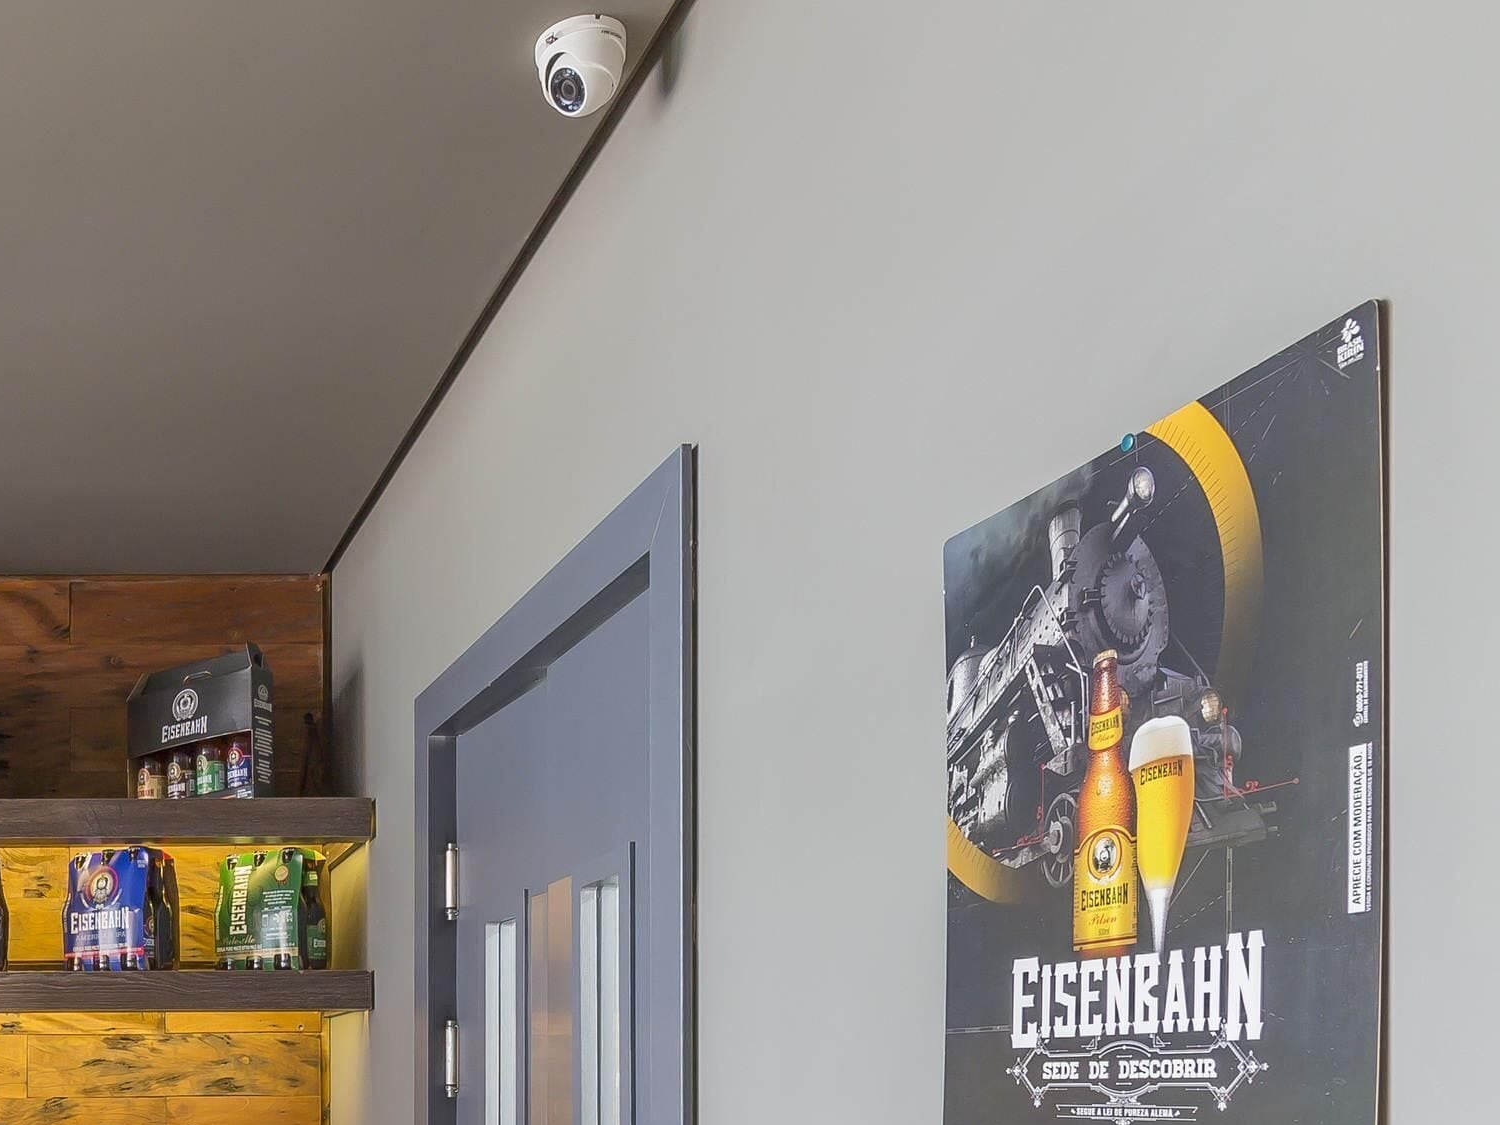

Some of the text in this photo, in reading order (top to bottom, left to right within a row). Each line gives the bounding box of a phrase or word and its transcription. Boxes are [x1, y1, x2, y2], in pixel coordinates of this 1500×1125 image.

[161, 715, 208, 743] EISENBAHN
[1091, 714, 1120, 737] EISENBAHN
[1140, 759, 1183, 785] EISENBAHN
[1351, 829, 1362, 856] COM
[1351, 858, 1362, 905] APRECIE
[230, 865, 253, 935] EISENBAHN
[1081, 882, 1129, 911] EISENBAHN
[70, 907, 129, 935] EISENBAHN
[1011, 929, 1266, 1048] EISENBAHN
[1042, 1058, 1217, 1079] SEDE DE DESCOBRIR
[1076, 1107, 1096, 1116] SEGUE
[1123, 1108, 1149, 1117] PUREZA
